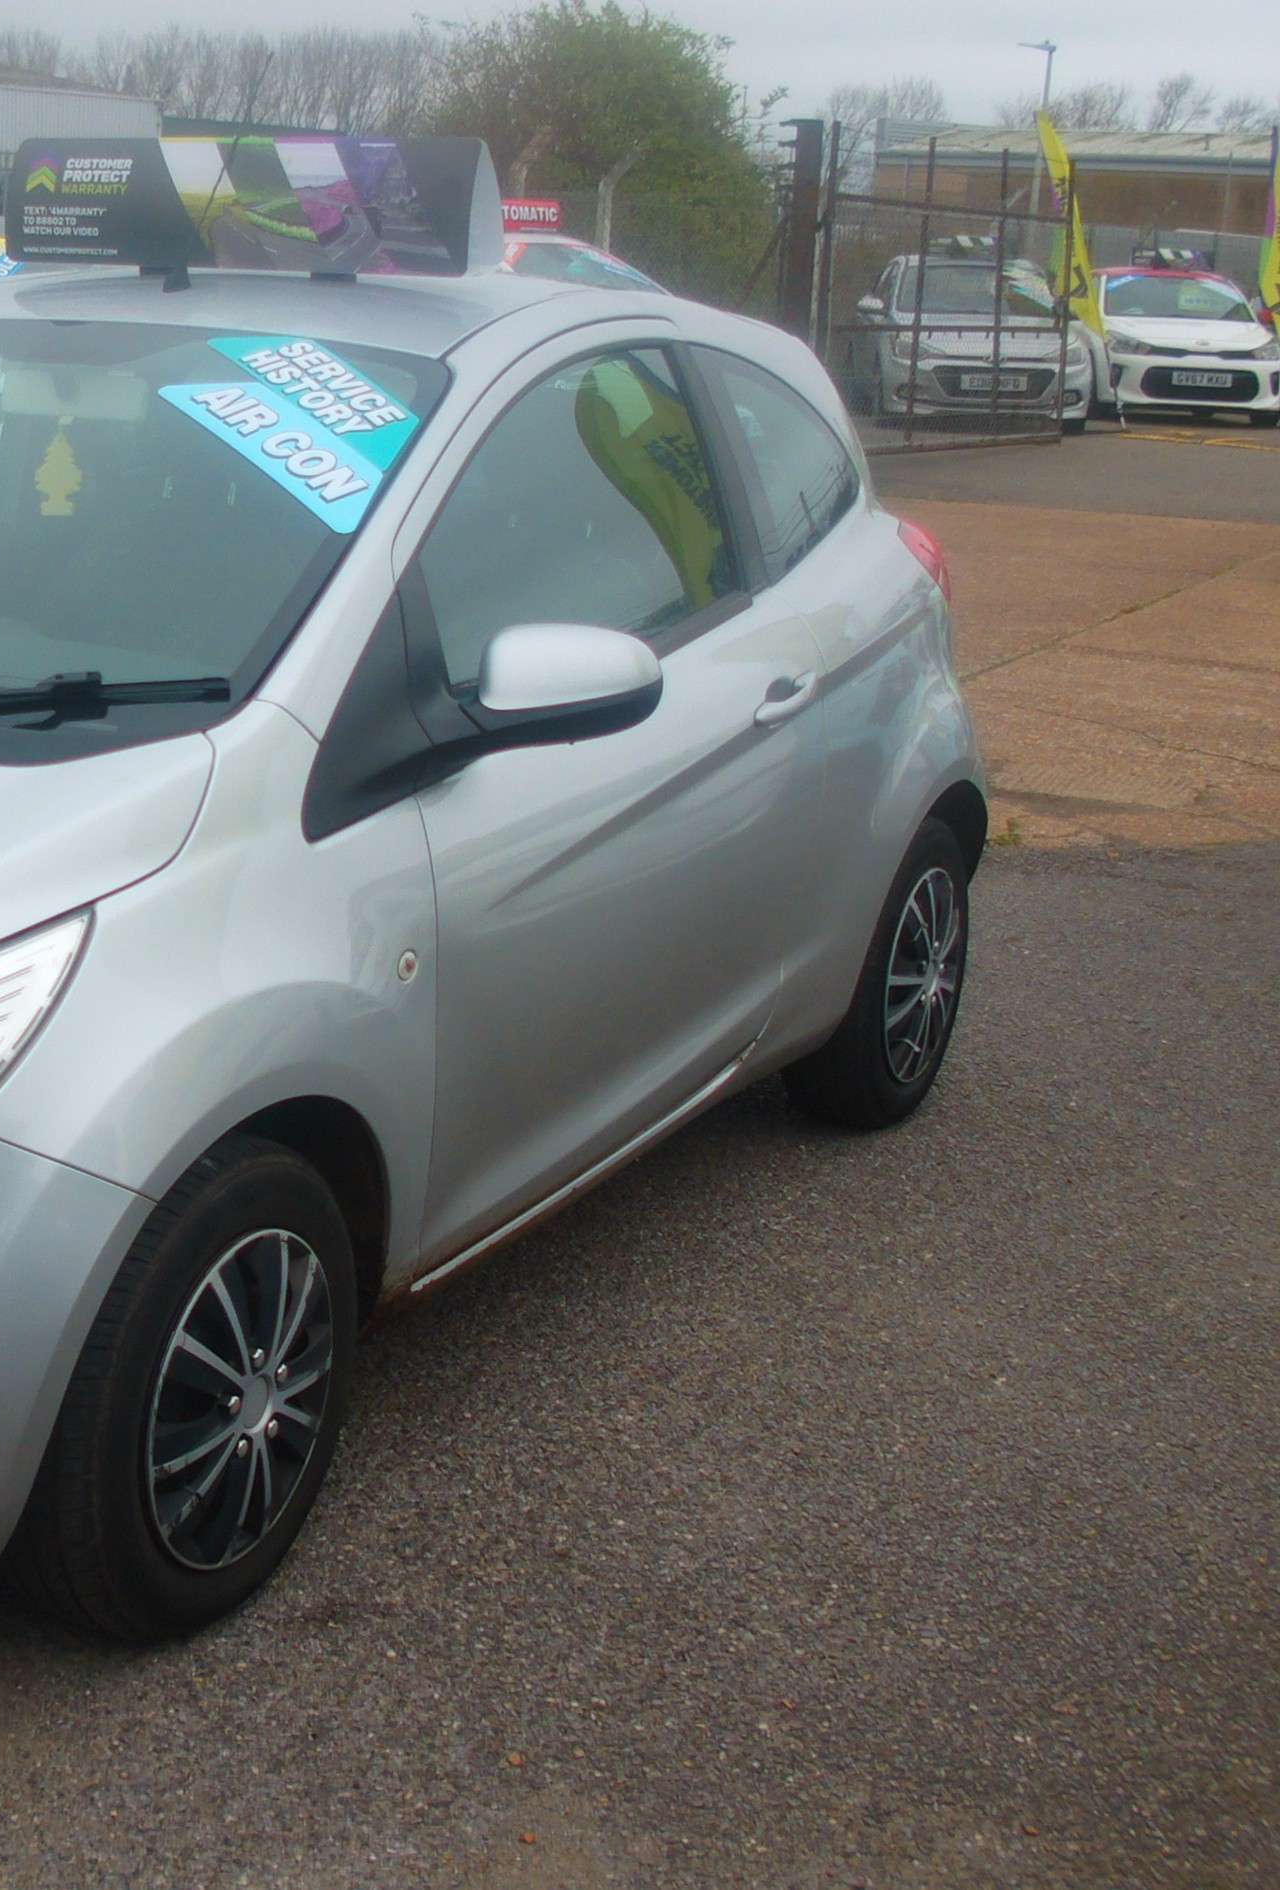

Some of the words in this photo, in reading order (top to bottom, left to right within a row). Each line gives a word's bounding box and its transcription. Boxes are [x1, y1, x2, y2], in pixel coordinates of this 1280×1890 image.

[66, 158, 133, 170] CUSTOMER
[63, 170, 131, 183] PROTECT
[62, 183, 128, 195] WARRANTY
[24, 216, 35, 226] TO
[66, 217, 77, 226] TO
[23, 226, 52, 236] WATCH
[53, 227, 72, 236] OUR
[73, 228, 100, 237] VIDEO
[278, 342, 408, 427] SERVICE
[240, 350, 375, 435] HISTORY
[192, 387, 280, 437] AIR
[260, 430, 370, 503] CON
